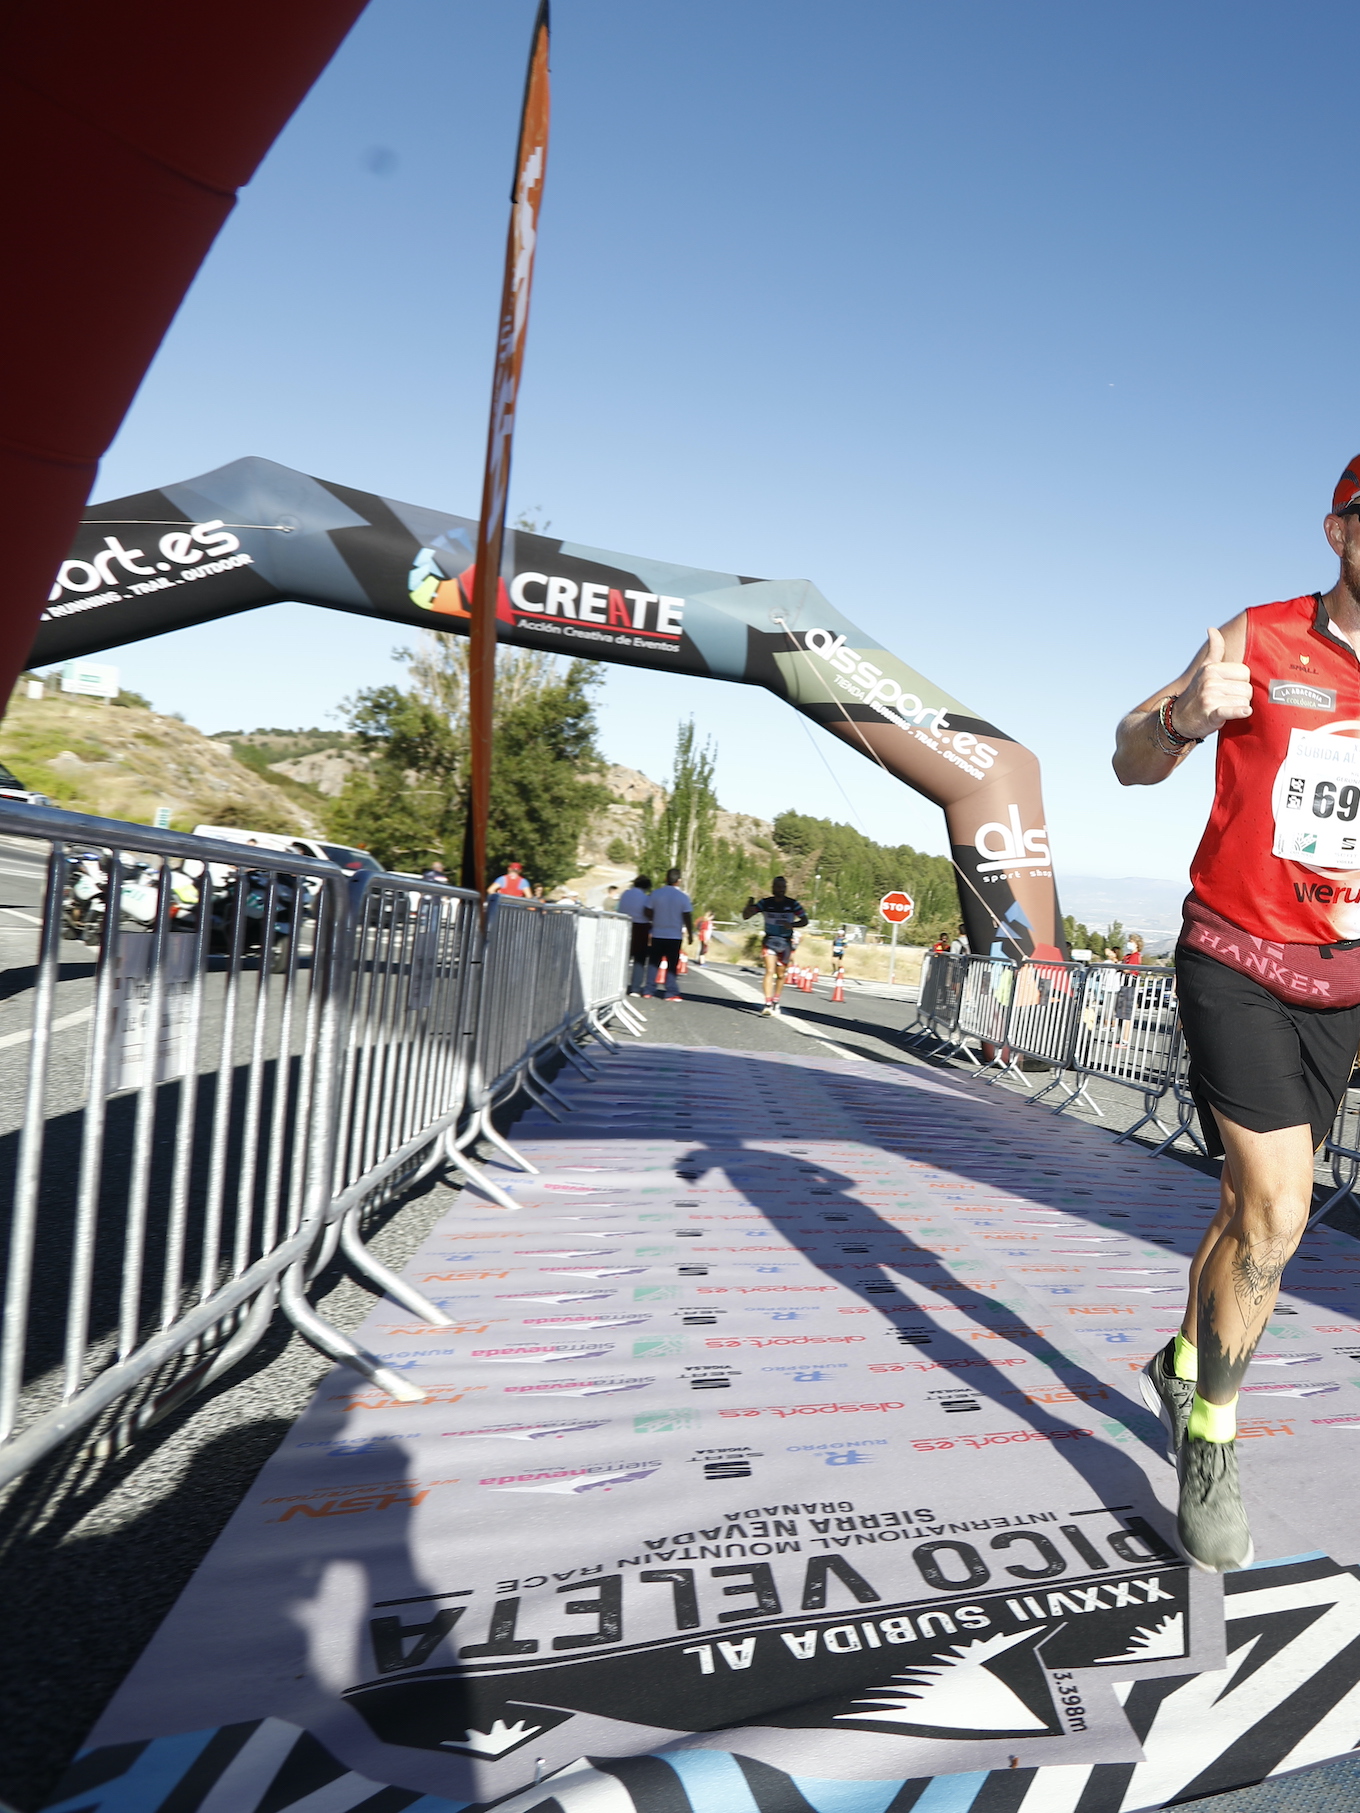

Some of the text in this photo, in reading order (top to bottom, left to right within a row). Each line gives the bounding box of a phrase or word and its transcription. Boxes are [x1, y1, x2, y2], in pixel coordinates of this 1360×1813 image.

[47, 553, 254, 618] RUNNING TRAIL OUTDOOR
[510, 571, 686, 636] CREATE
[516, 618, 681, 653] Acción Creativa de Eventos
[804, 627, 999, 770] alssport.es
[1280, 688, 1290, 697] LA
[833, 674, 986, 781] TIENDA RUNNING TRAIL OUTDOOR
[1296, 744, 1340, 763] SUBIDA
[1342, 753, 1357, 765] AL
[982, 870, 1021, 883] sport
[881, 902, 911, 913] STOP
[1199, 930, 1331, 997] HANKER
[470, 1342, 616, 1358] sierranevada
[705, 1335, 867, 1349] alssport.es
[676, 1370, 743, 1379] SEAT
[868, 1357, 1028, 1374] alssport.es
[717, 1400, 905, 1418] alssport.es
[1024, 1389, 1111, 1406] HSN
[910, 1427, 1095, 1452] alssport.es
[1235, 1424, 1295, 1440] HS
[686, 1451, 764, 1463] SEAT
[786, 1439, 889, 1452] RUNOPRO
[478, 1459, 662, 1486] sierranevada
[277, 1489, 431, 1524] HSN
[723, 1501, 854, 1521] GRANADA
[644, 1508, 936, 1550] SIERRA NEVADA
[496, 1511, 1058, 1595] INTERNATIONAL MOUNTAIN RACE
[370, 1516, 1177, 1675] PICO VELETA
[683, 1577, 1175, 1675] XXXVII SUBIDA AL
[1052, 1670, 1088, 1734] 3.398m
